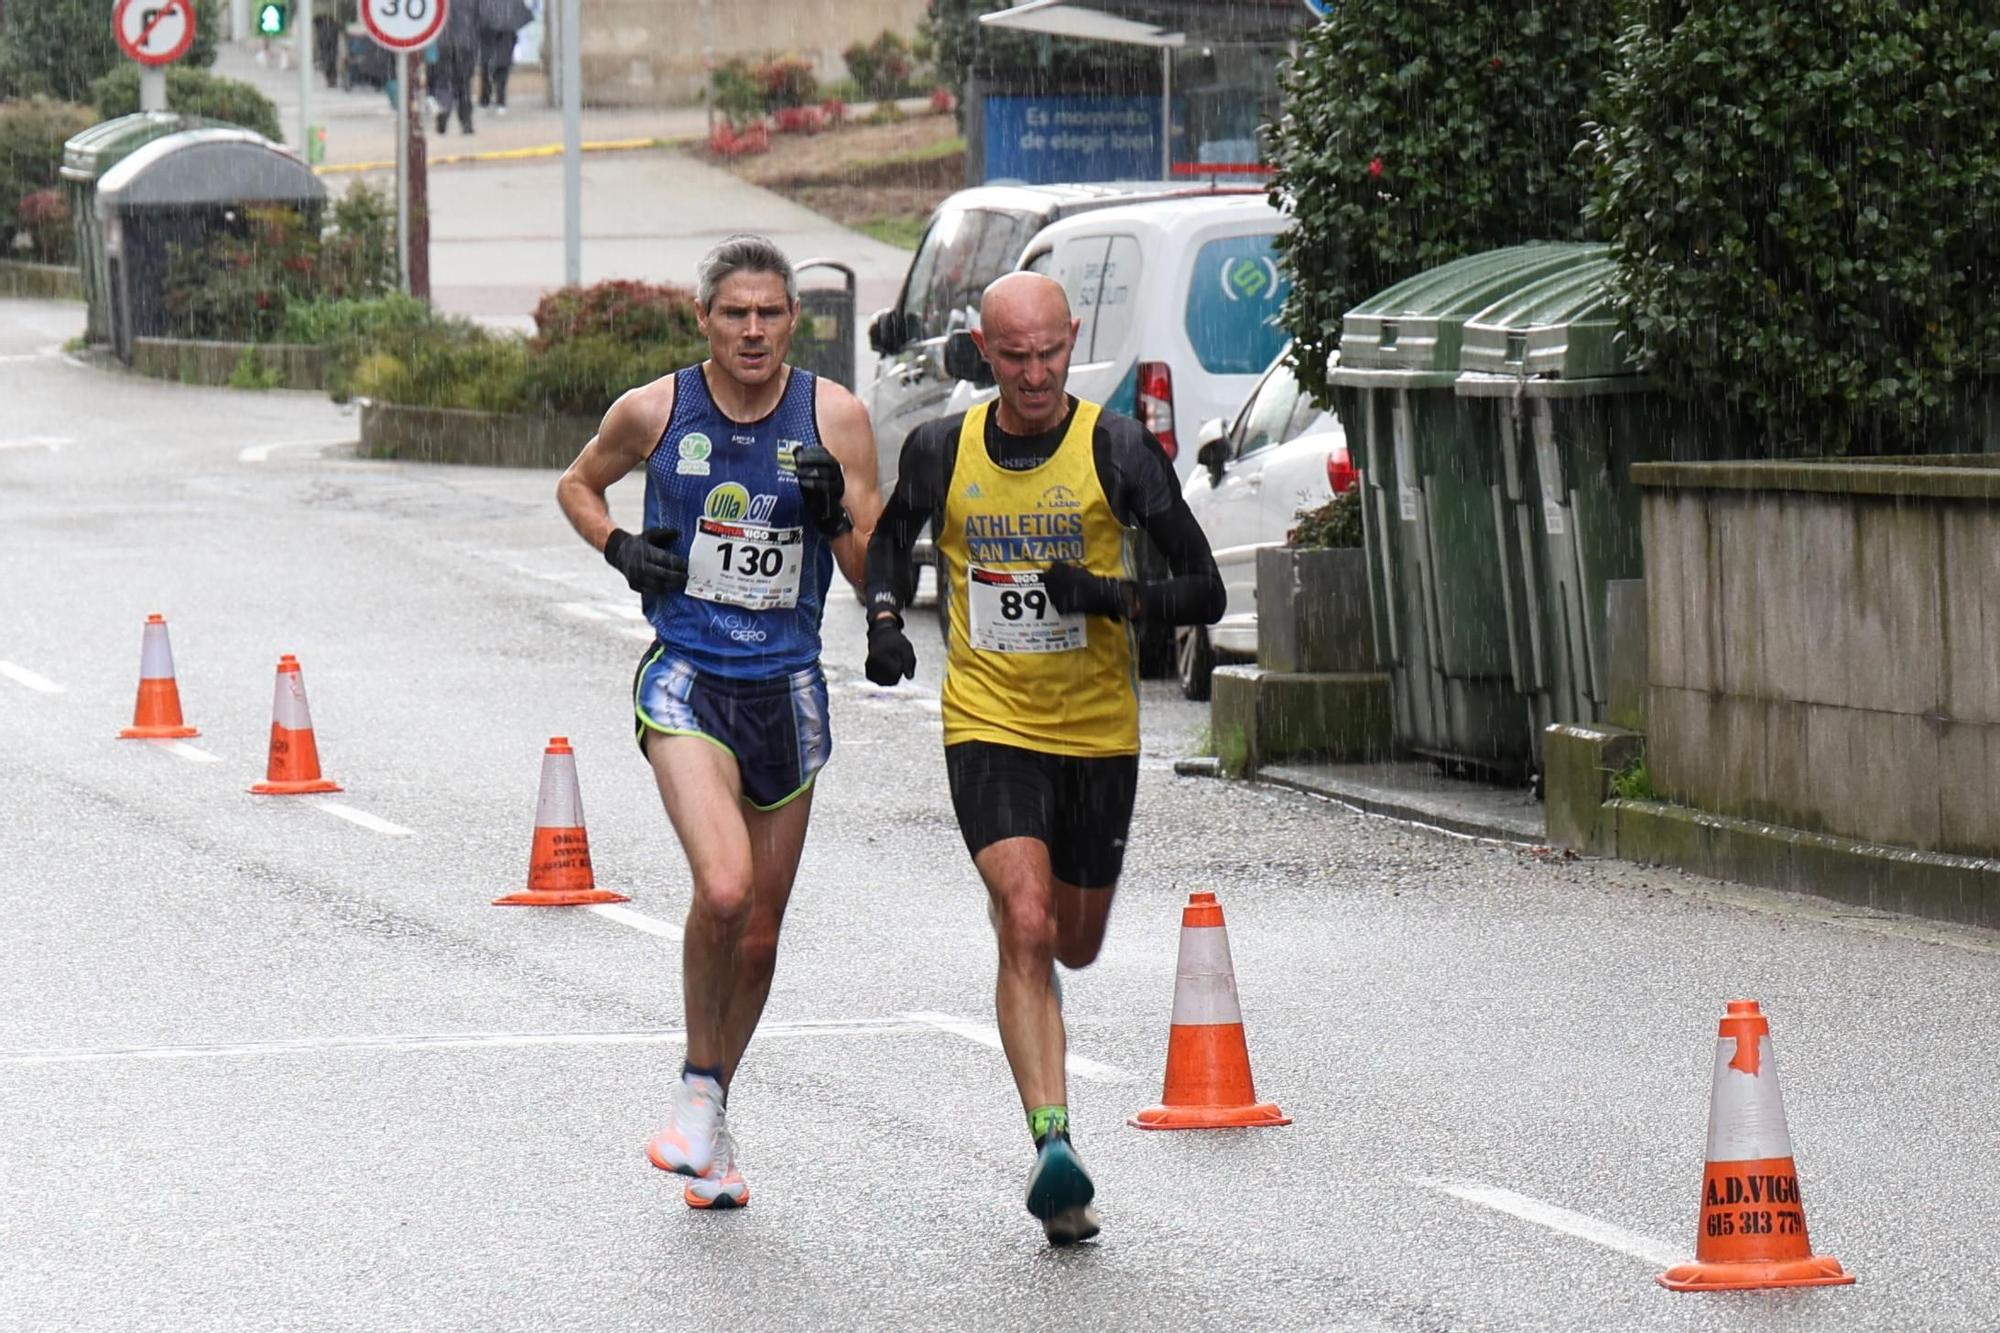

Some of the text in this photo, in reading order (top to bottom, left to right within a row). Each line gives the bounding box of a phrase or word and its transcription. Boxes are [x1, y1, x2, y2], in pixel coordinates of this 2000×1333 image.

[381, 0, 425, 19] 30
[1025, 107, 1149, 126] Es momento
[1020, 130, 1045, 149] de
[711, 494, 778, 520] Ulla Oil
[965, 513, 1083, 536] ATHLETICS
[716, 542, 784, 577] 130
[1000, 589, 1047, 621] 89
[1706, 1210, 1802, 1238] 615 313 779
